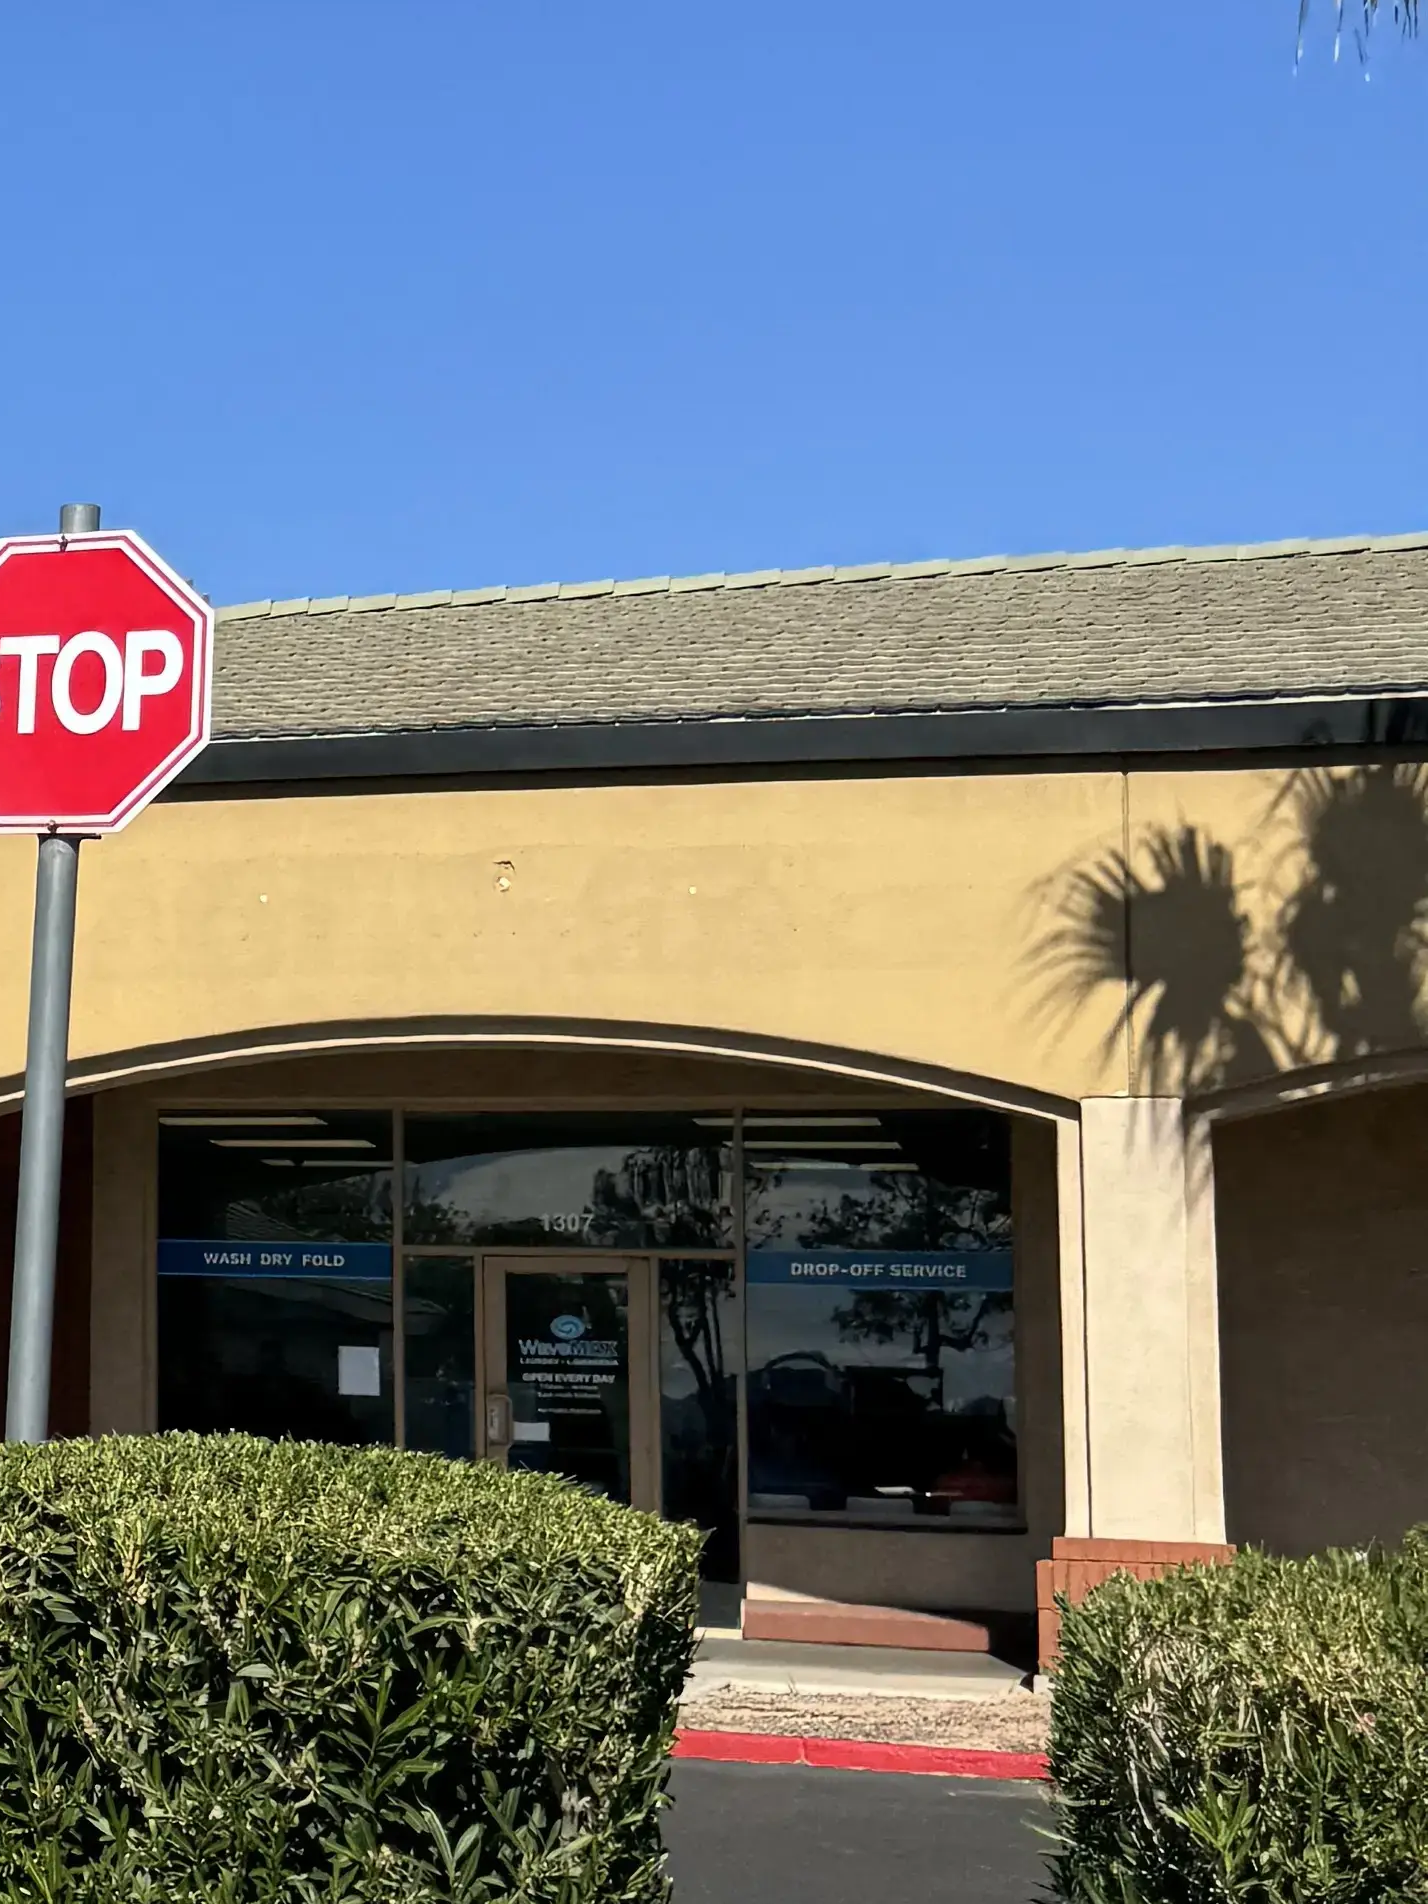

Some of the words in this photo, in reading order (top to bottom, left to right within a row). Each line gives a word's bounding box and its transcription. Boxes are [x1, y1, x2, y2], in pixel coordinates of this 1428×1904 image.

[539, 1213, 595, 1232] 1307
[204, 1252, 252, 1265] WASH
[260, 1253, 293, 1265] DRY
[302, 1254, 345, 1267] FOLD
[790, 1262, 885, 1277] DROP-OFF
[889, 1264, 967, 1278] SERVICE
